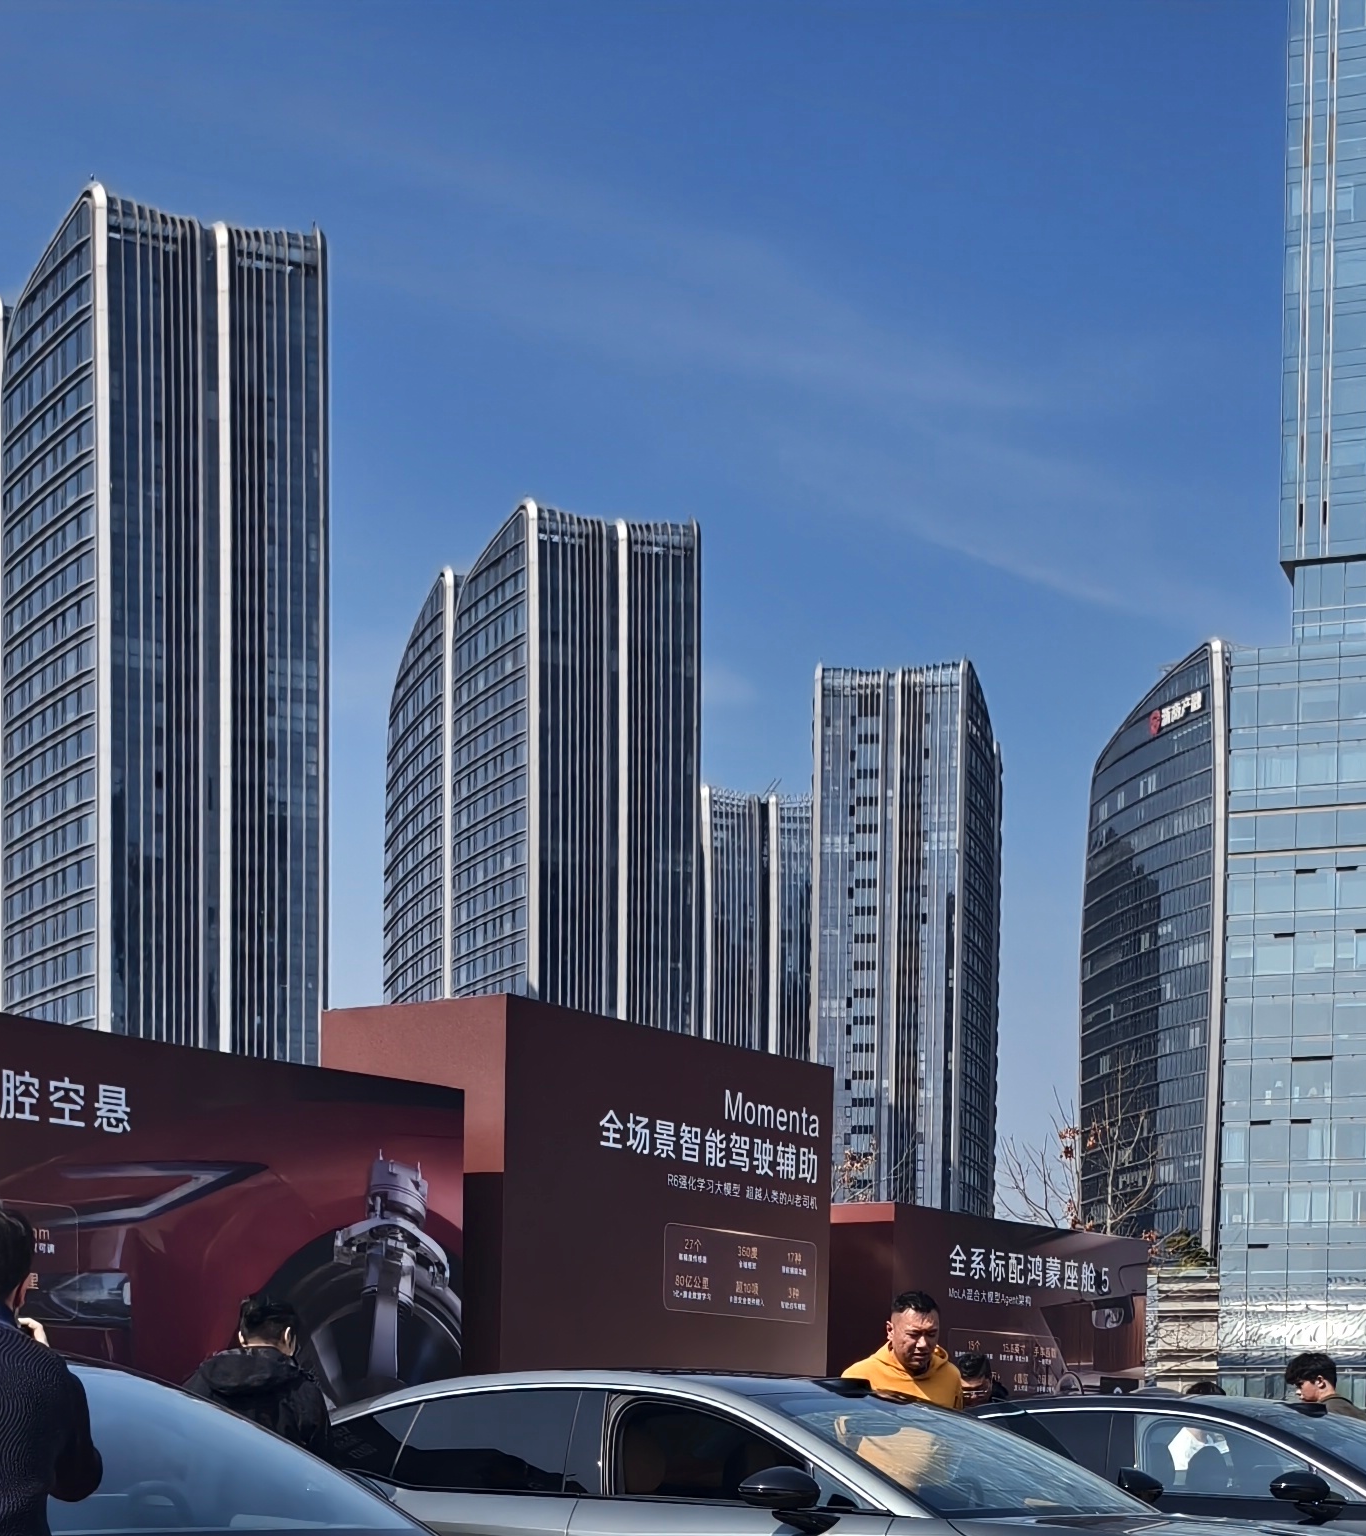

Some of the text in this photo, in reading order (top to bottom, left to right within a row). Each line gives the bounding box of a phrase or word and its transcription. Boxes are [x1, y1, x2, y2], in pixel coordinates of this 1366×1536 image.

[724, 1089, 820, 1138] Momenta
[599, 1109, 819, 1184] 全场景智能驾驶辅助
[667, 1173, 818, 1211] R6强化学习大模型 超越人类的AI老司机
[674, 1274, 710, 1290] 80亿公里
[949, 1244, 1110, 1293] 全系标配鸿蒙座舱 5
